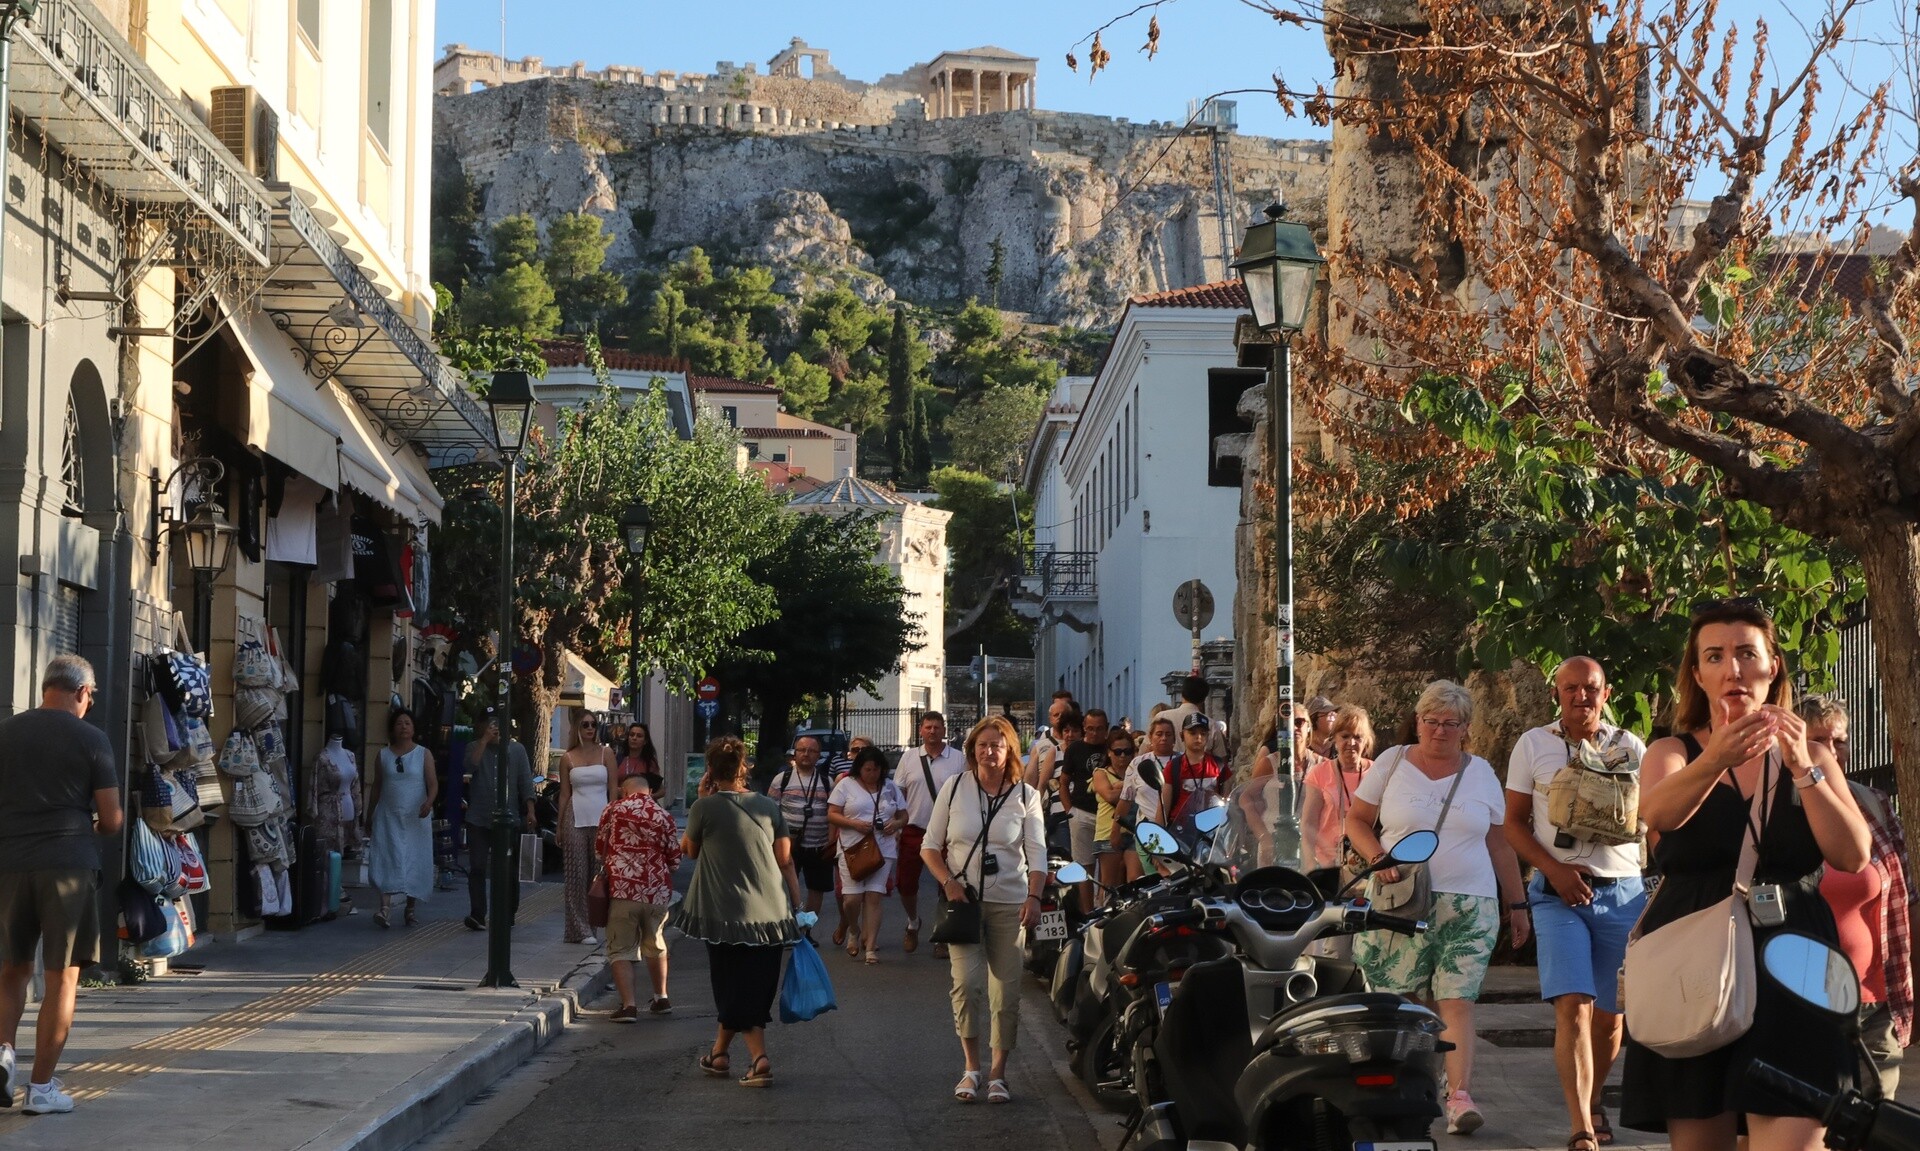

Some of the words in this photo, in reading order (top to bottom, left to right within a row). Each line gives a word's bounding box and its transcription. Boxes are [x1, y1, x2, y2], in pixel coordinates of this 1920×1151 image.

[1042, 913, 1064, 924] OTA
[1044, 926, 1066, 937] 183
[1159, 997, 1171, 1005] GR
